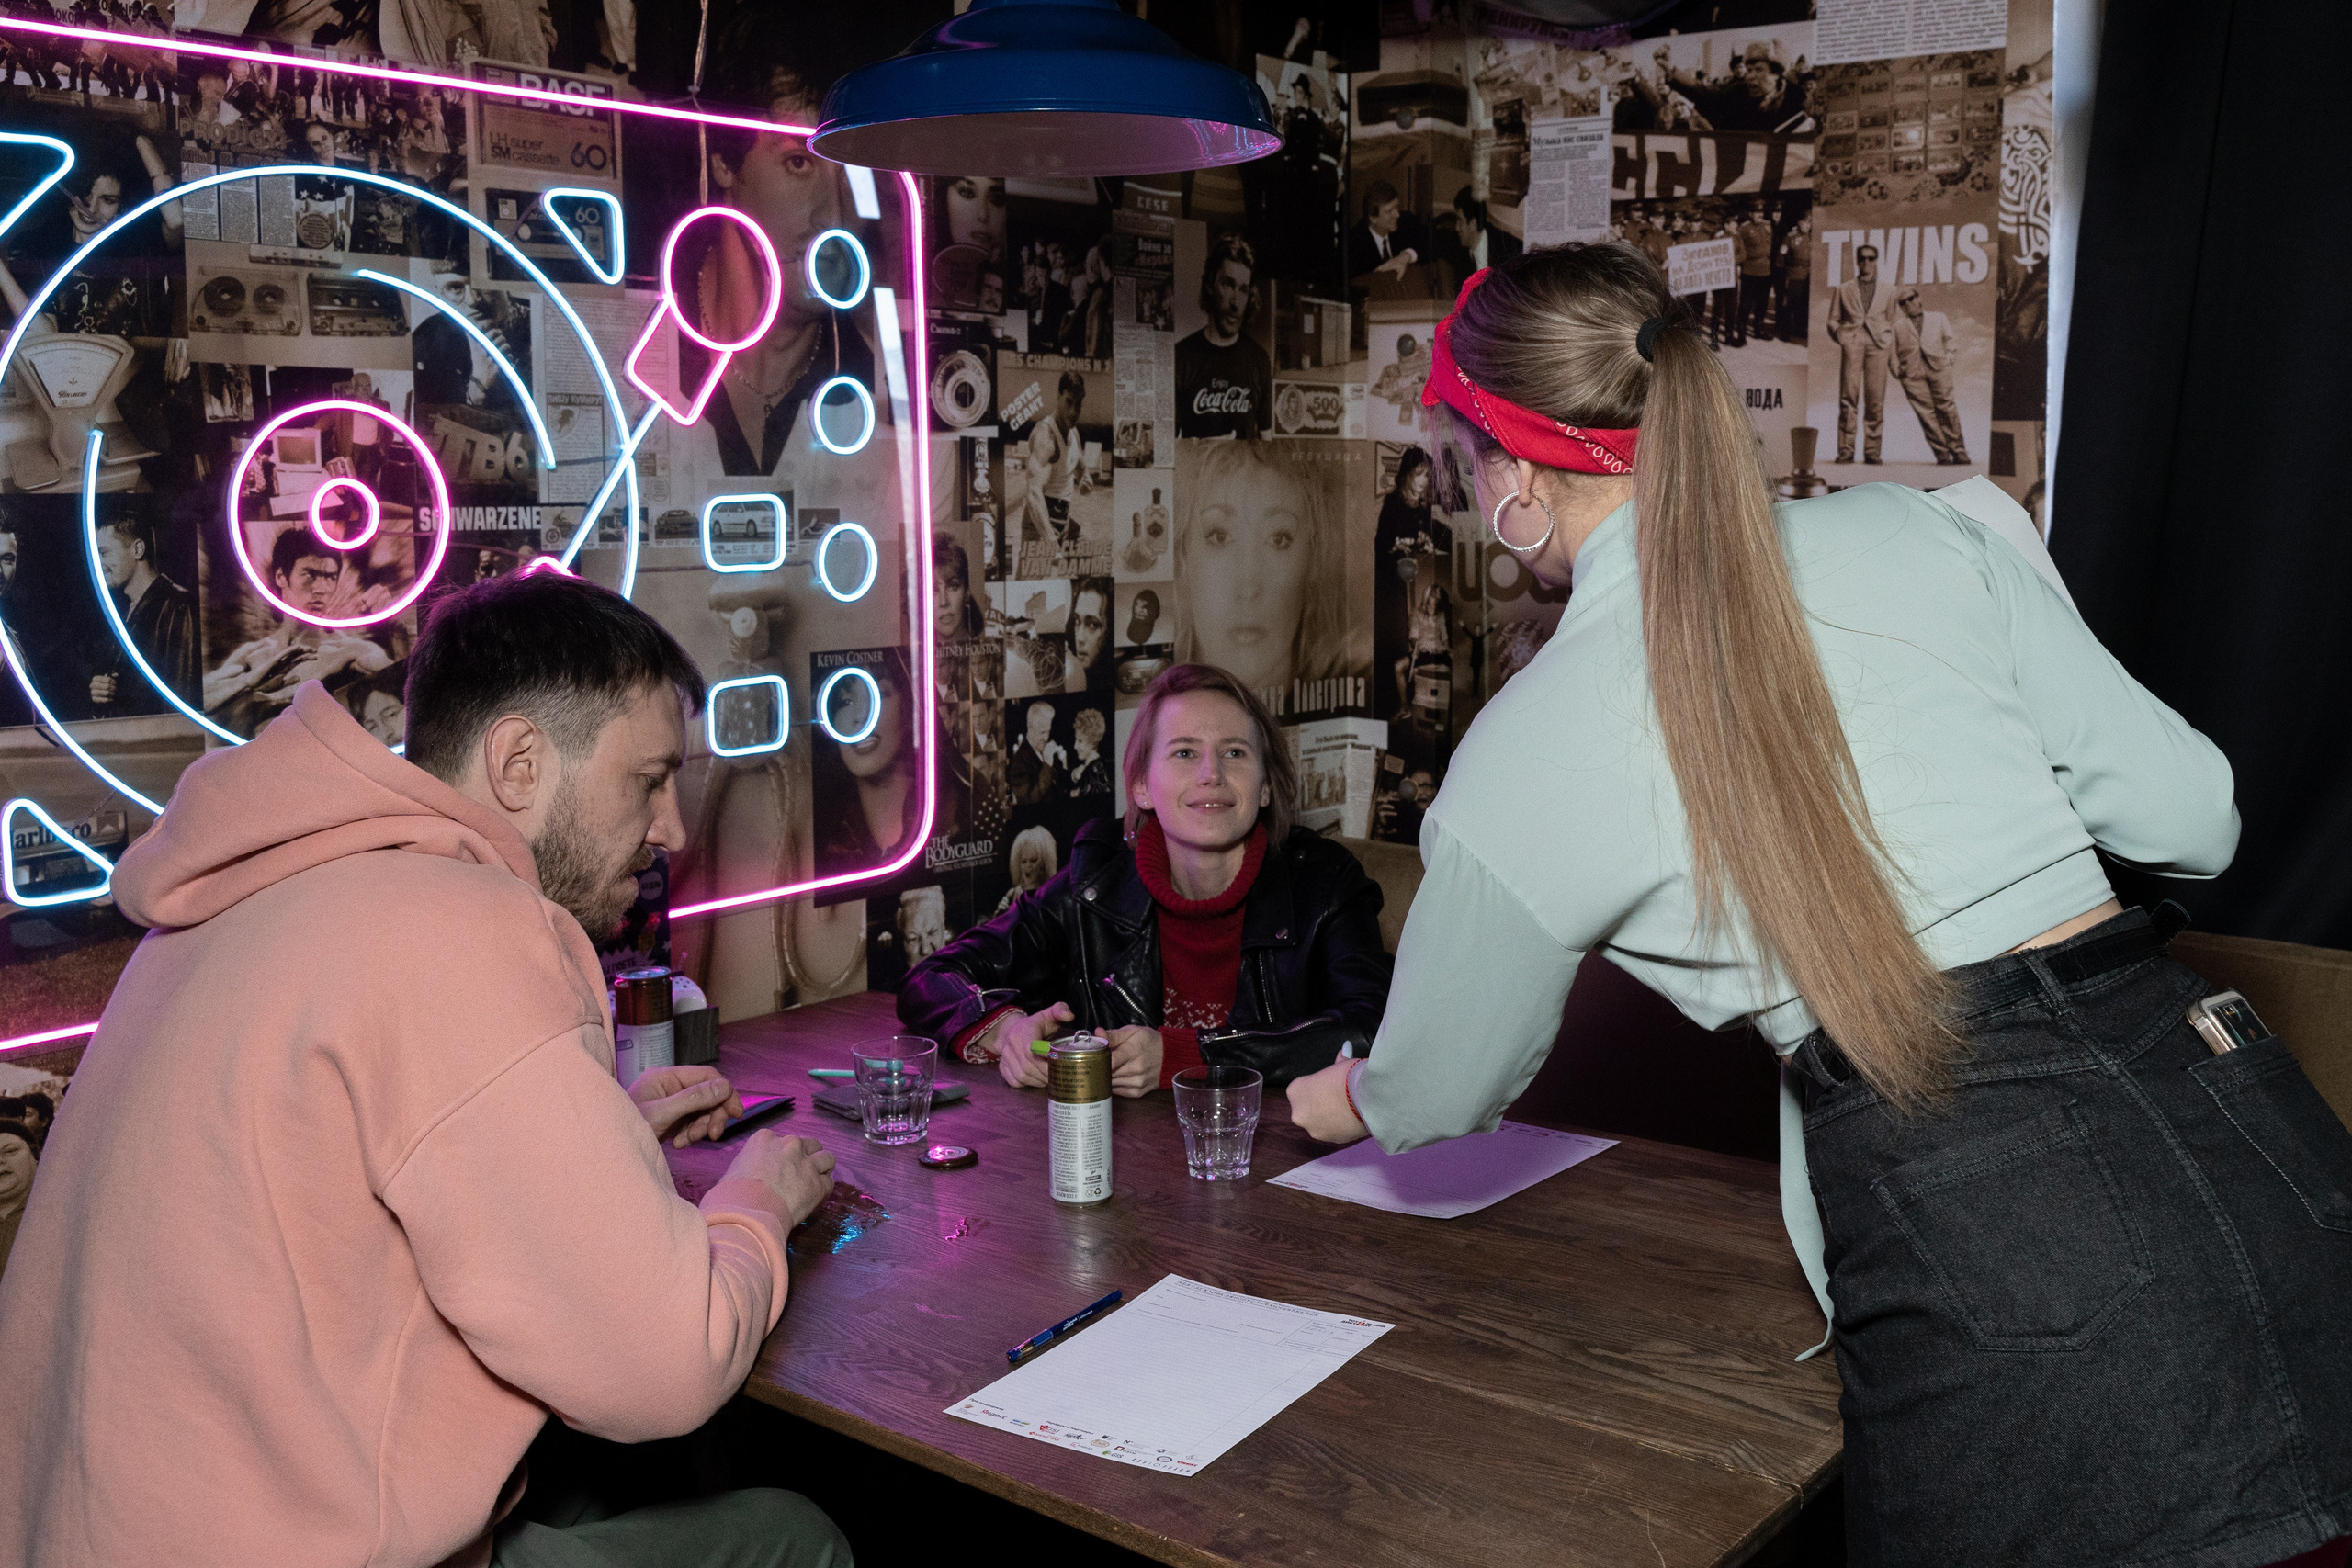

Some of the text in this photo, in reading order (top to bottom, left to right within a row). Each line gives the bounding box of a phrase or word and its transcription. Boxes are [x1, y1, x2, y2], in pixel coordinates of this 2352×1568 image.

[510, 138, 544, 152] super
[513, 150, 560, 166] cassette
[571, 141, 606, 171] 60
[575, 206, 599, 225] 60
[1822, 223, 1989, 288] TWINS
[1000, 381, 1042, 423] POSTER
[1313, 397, 1340, 412] 500
[817, 650, 884, 668] KEVIN COSTNER
[935, 643, 1001, 659] HITNEY HOUSTON
[14, 822, 91, 849] arlbro
[932, 834, 950, 848] THE
[925, 840, 993, 869] BODYGUARD
